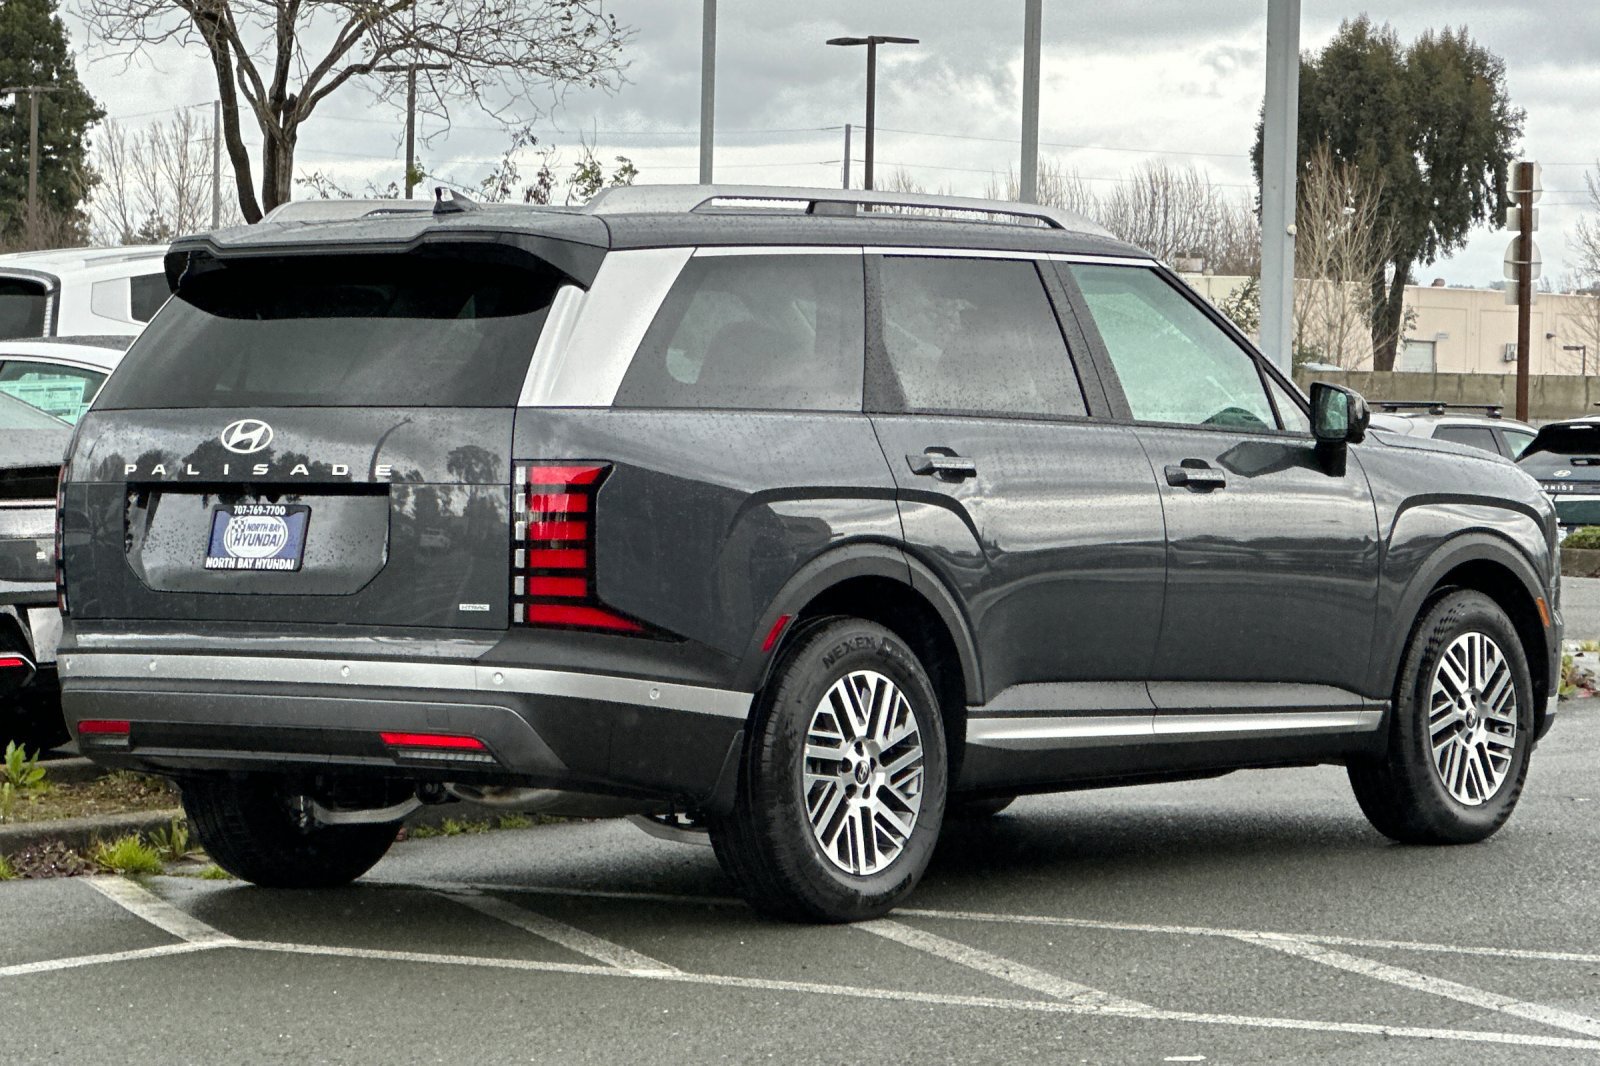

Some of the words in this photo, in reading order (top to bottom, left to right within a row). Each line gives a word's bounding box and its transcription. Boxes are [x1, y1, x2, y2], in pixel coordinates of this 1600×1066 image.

[124, 463, 393, 476] PALISADE
[233, 505, 286, 515] 707-769-7700
[246, 523, 268, 532] NORTH
[269, 523, 281, 532] BAY
[233, 533, 282, 546] HYUNDAI
[205, 557, 236, 569] NORTH
[237, 557, 255, 569] BAY
[255, 558, 295, 570] HYUNDAI
[822, 636, 876, 670] NEXEN
